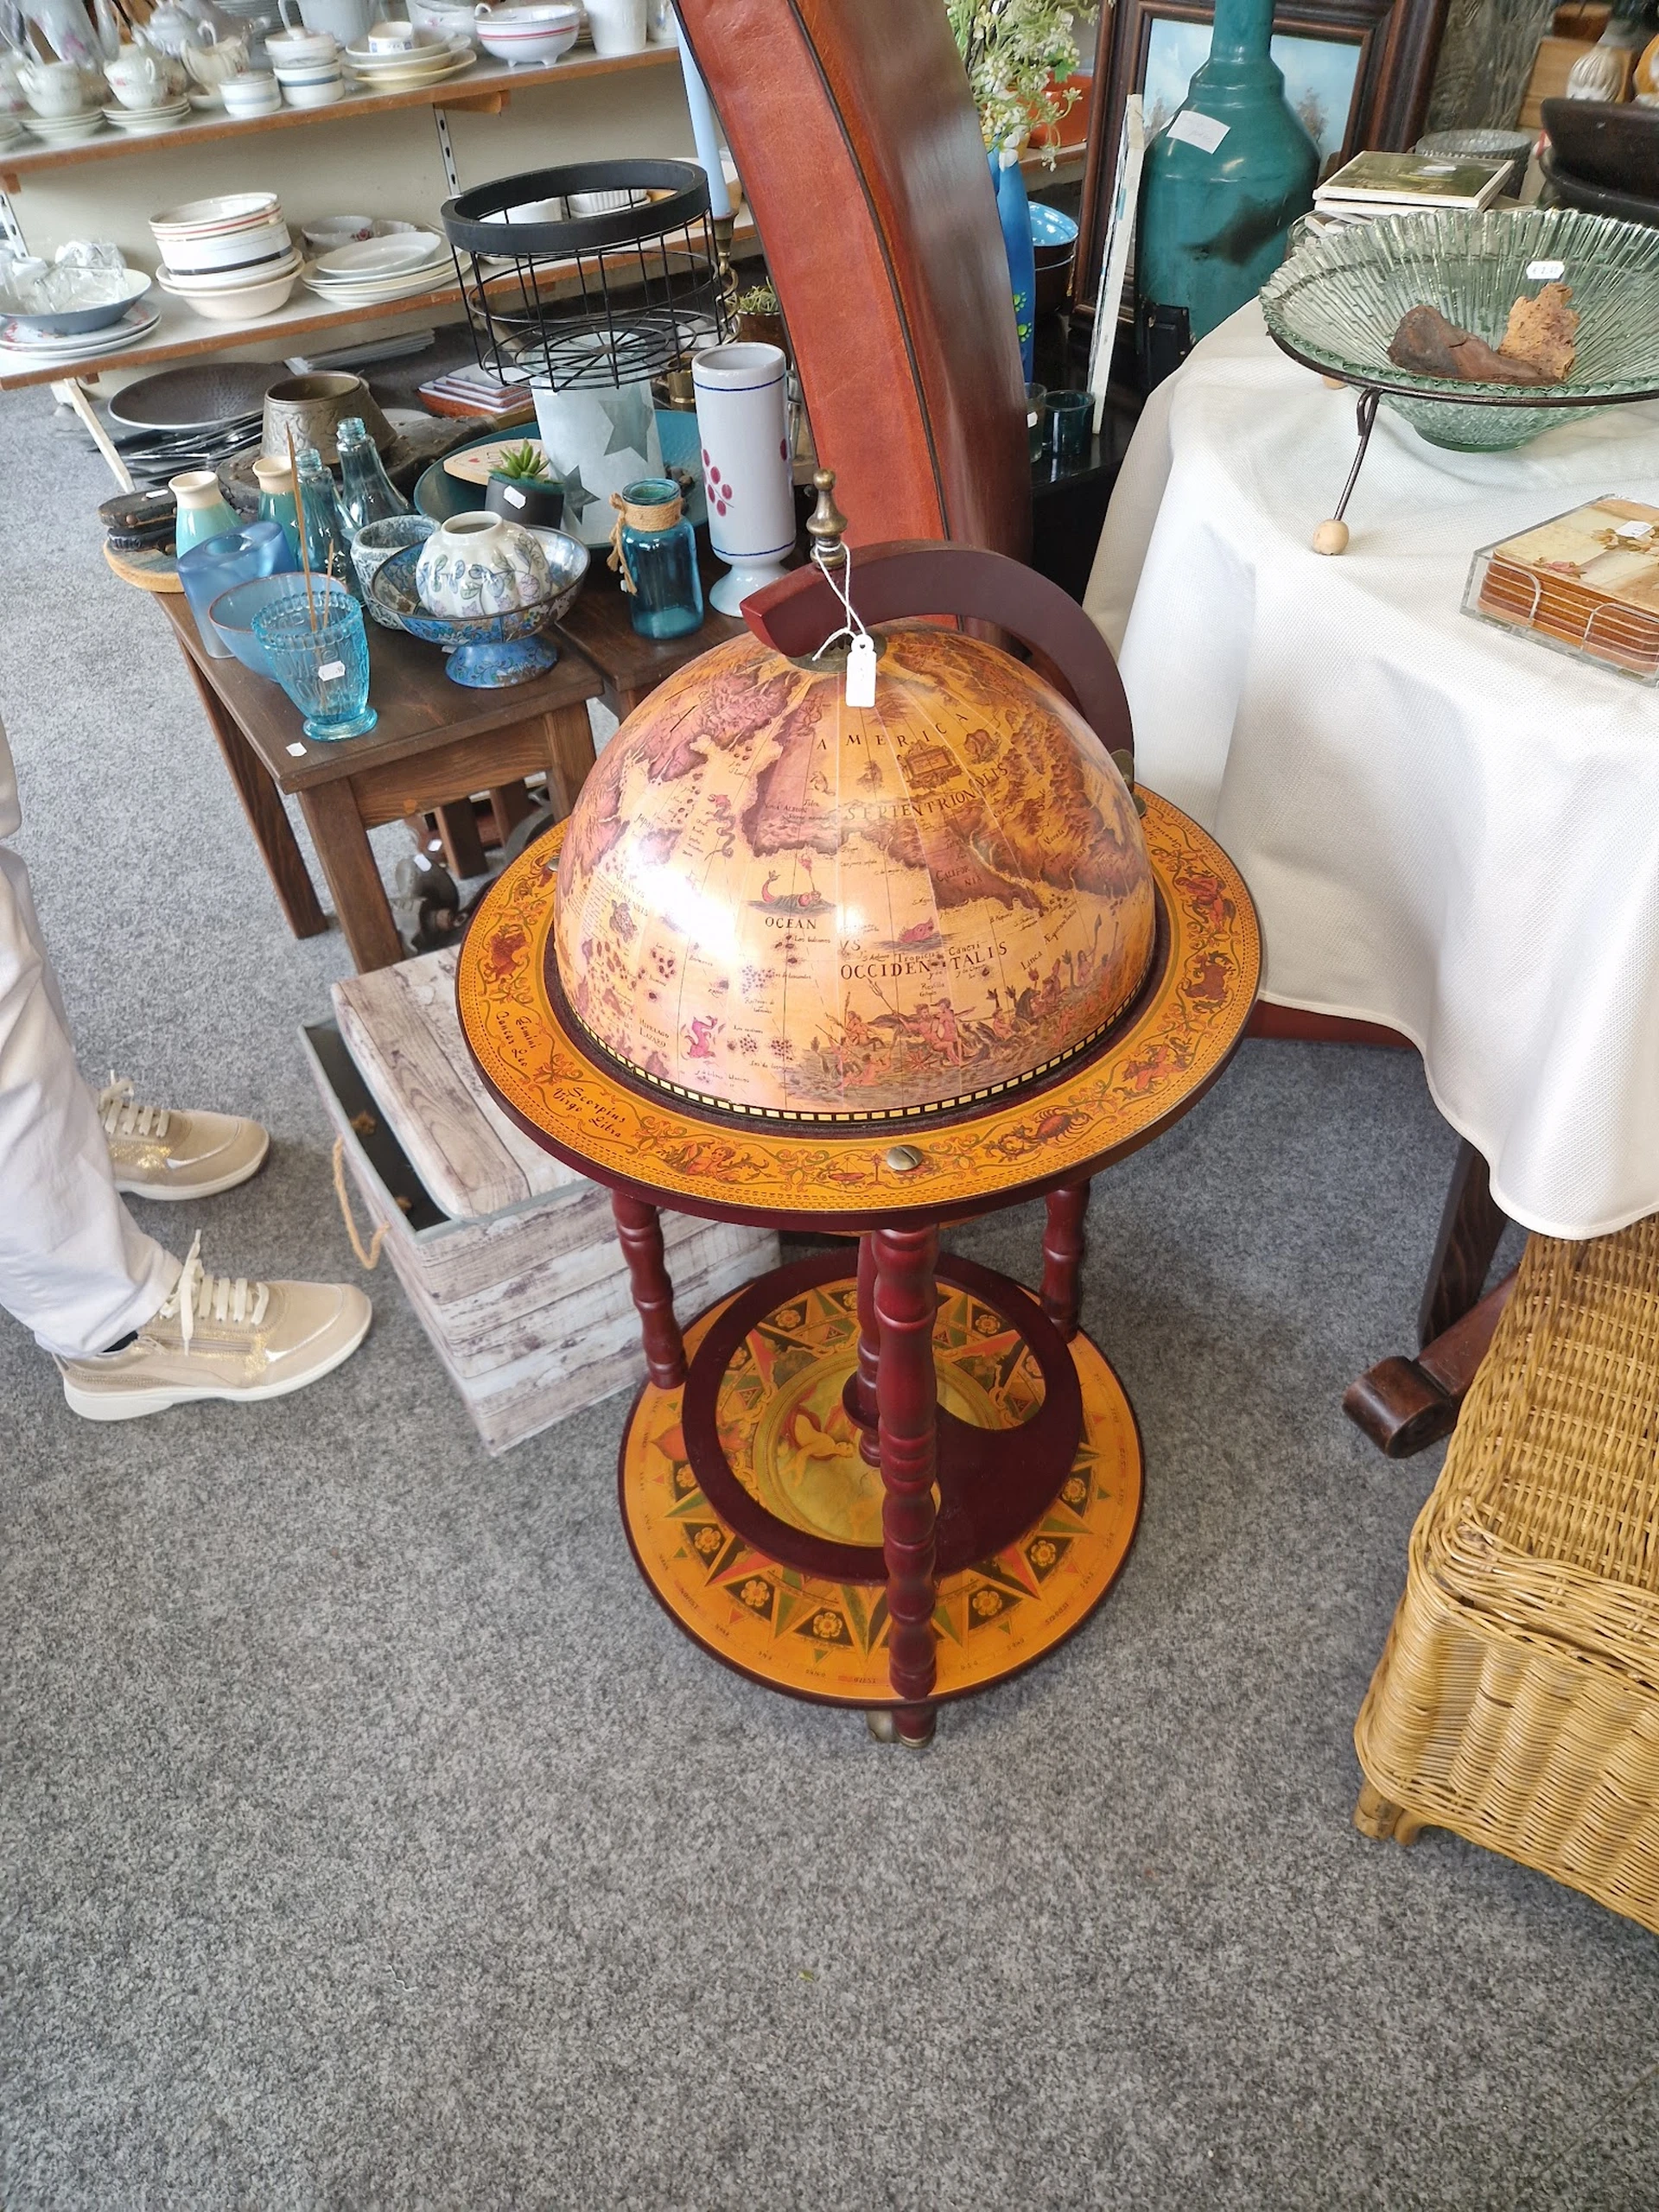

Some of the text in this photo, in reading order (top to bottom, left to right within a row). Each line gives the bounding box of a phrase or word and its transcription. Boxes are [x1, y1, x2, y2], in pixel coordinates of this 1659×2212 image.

[817, 713, 969, 751] AMERICA
[516, 1015, 542, 1049] Gemini
[552, 1086, 621, 1138] Virgo Libra
[567, 1086, 626, 1123] Scorpius
